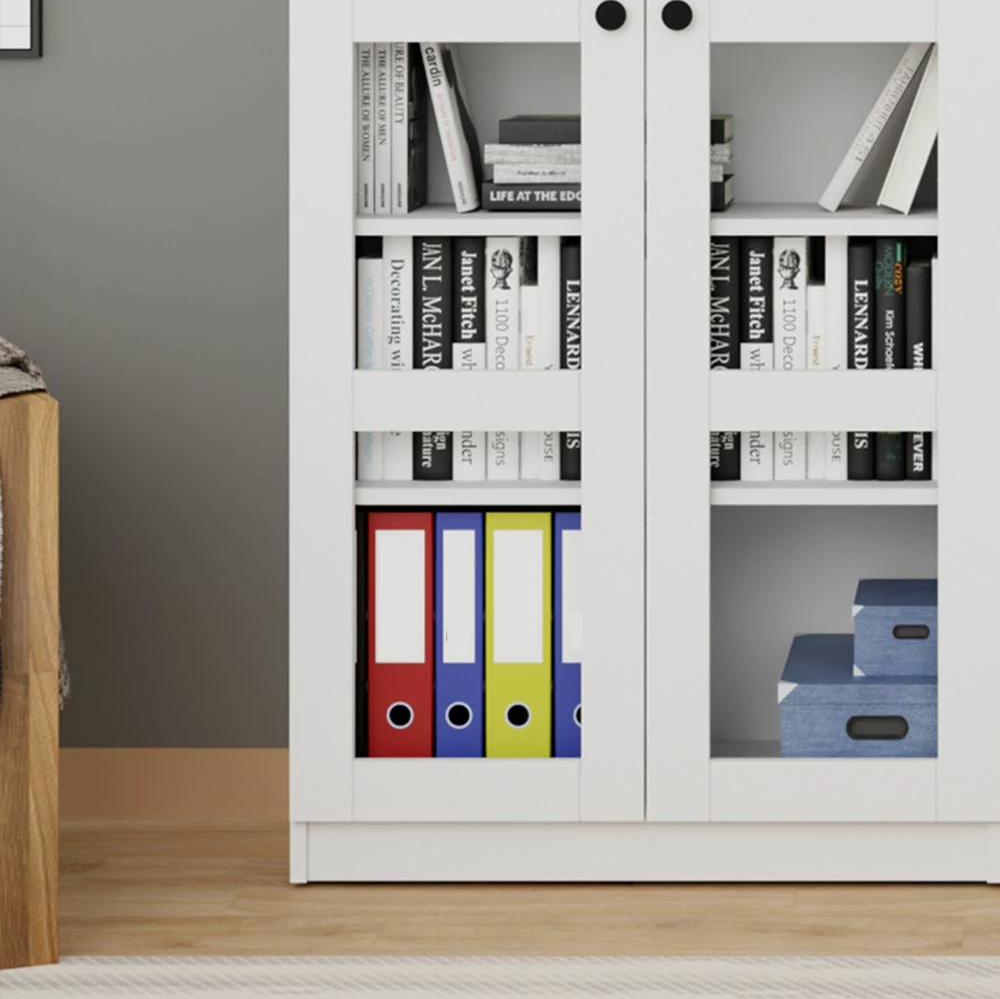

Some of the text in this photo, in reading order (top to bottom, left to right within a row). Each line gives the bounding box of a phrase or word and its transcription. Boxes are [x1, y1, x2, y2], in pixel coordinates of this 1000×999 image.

[361, 49, 370, 162] THE ALLURE OF WOMEN
[378, 49, 387, 146] THE ALLURE OF MEN
[395, 66, 405, 125] OF BEAUTY
[425, 46, 443, 87] cardin
[490, 191, 557, 202] LIFE AT THE
[388, 259, 405, 345] Decorating
[461, 250, 477, 339] Janet Fitch
[496, 300, 509, 370] 1100 Deco
[567, 279, 581, 370] LENNARD
[749, 250, 765, 339] Janet Fitch
[783, 300, 796, 370] 1100 Deco
[854, 279, 869, 370] LENNARD
[885, 309, 895, 329] Kim
